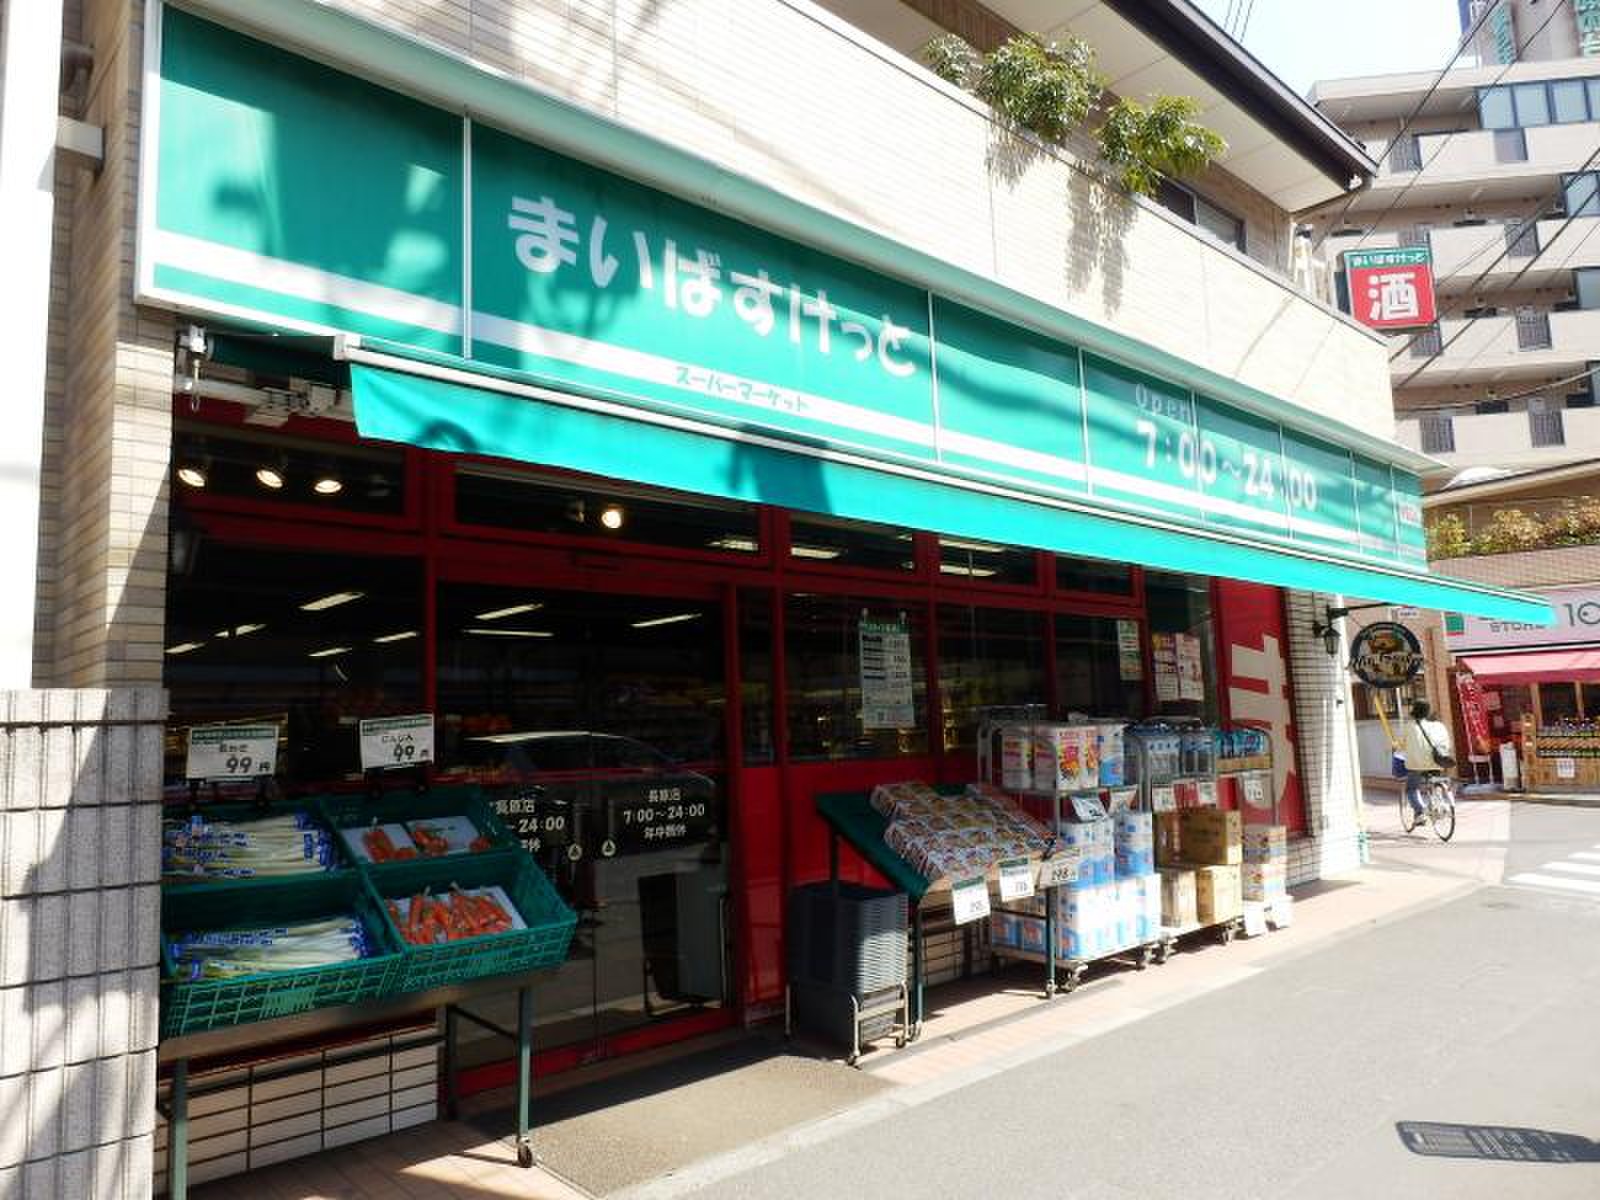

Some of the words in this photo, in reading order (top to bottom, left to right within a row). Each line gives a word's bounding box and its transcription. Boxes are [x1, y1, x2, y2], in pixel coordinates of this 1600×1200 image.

[508, 196, 917, 377] まいばすけっと
[1368, 272, 1419, 320] 酒
[676, 367, 809, 412] スーパーマーケット
[226, 756, 252, 773] 99
[393, 745, 415, 762] 99
